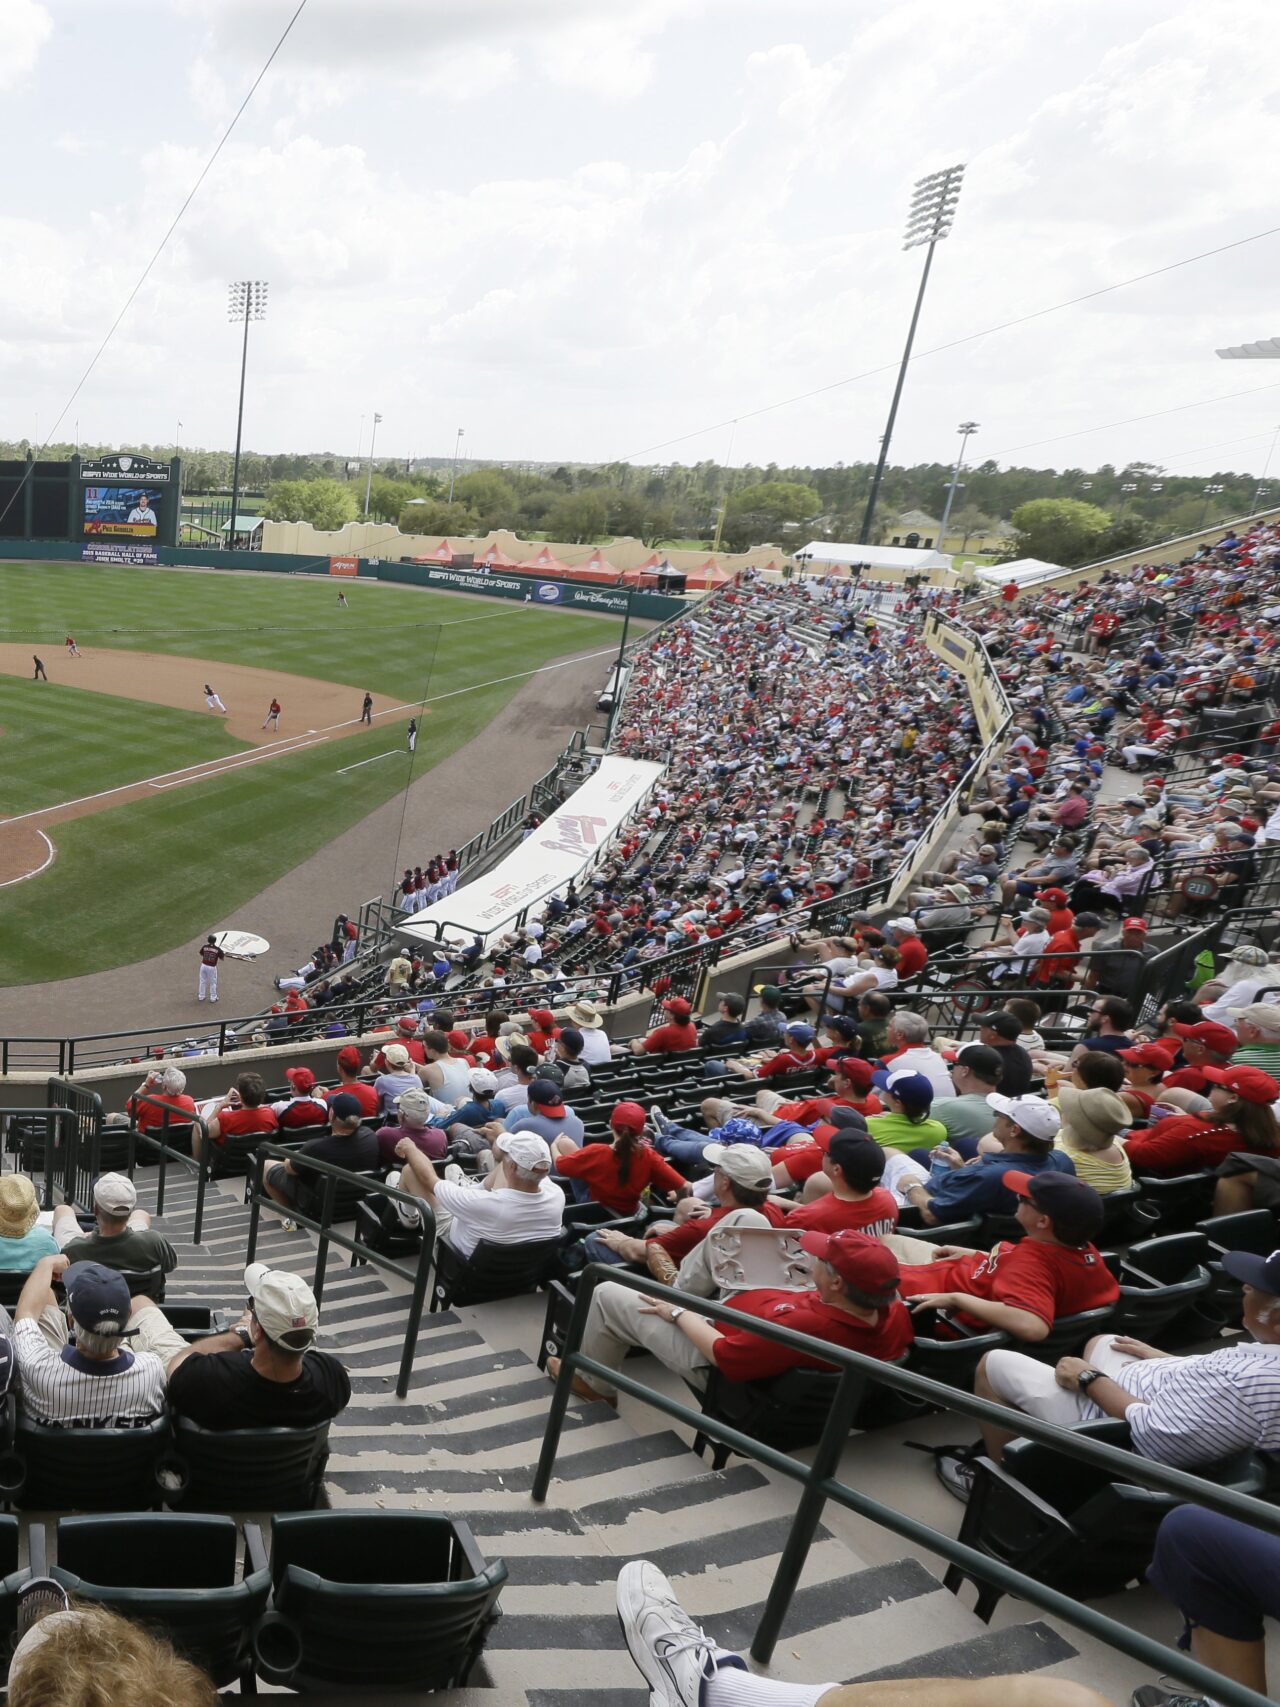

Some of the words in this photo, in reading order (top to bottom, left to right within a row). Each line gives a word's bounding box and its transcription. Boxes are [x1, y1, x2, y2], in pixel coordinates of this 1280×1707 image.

[429, 571, 448, 580] ESPN
[495, 580, 520, 590] SPORTS
[1188, 882, 1206, 895] 211
